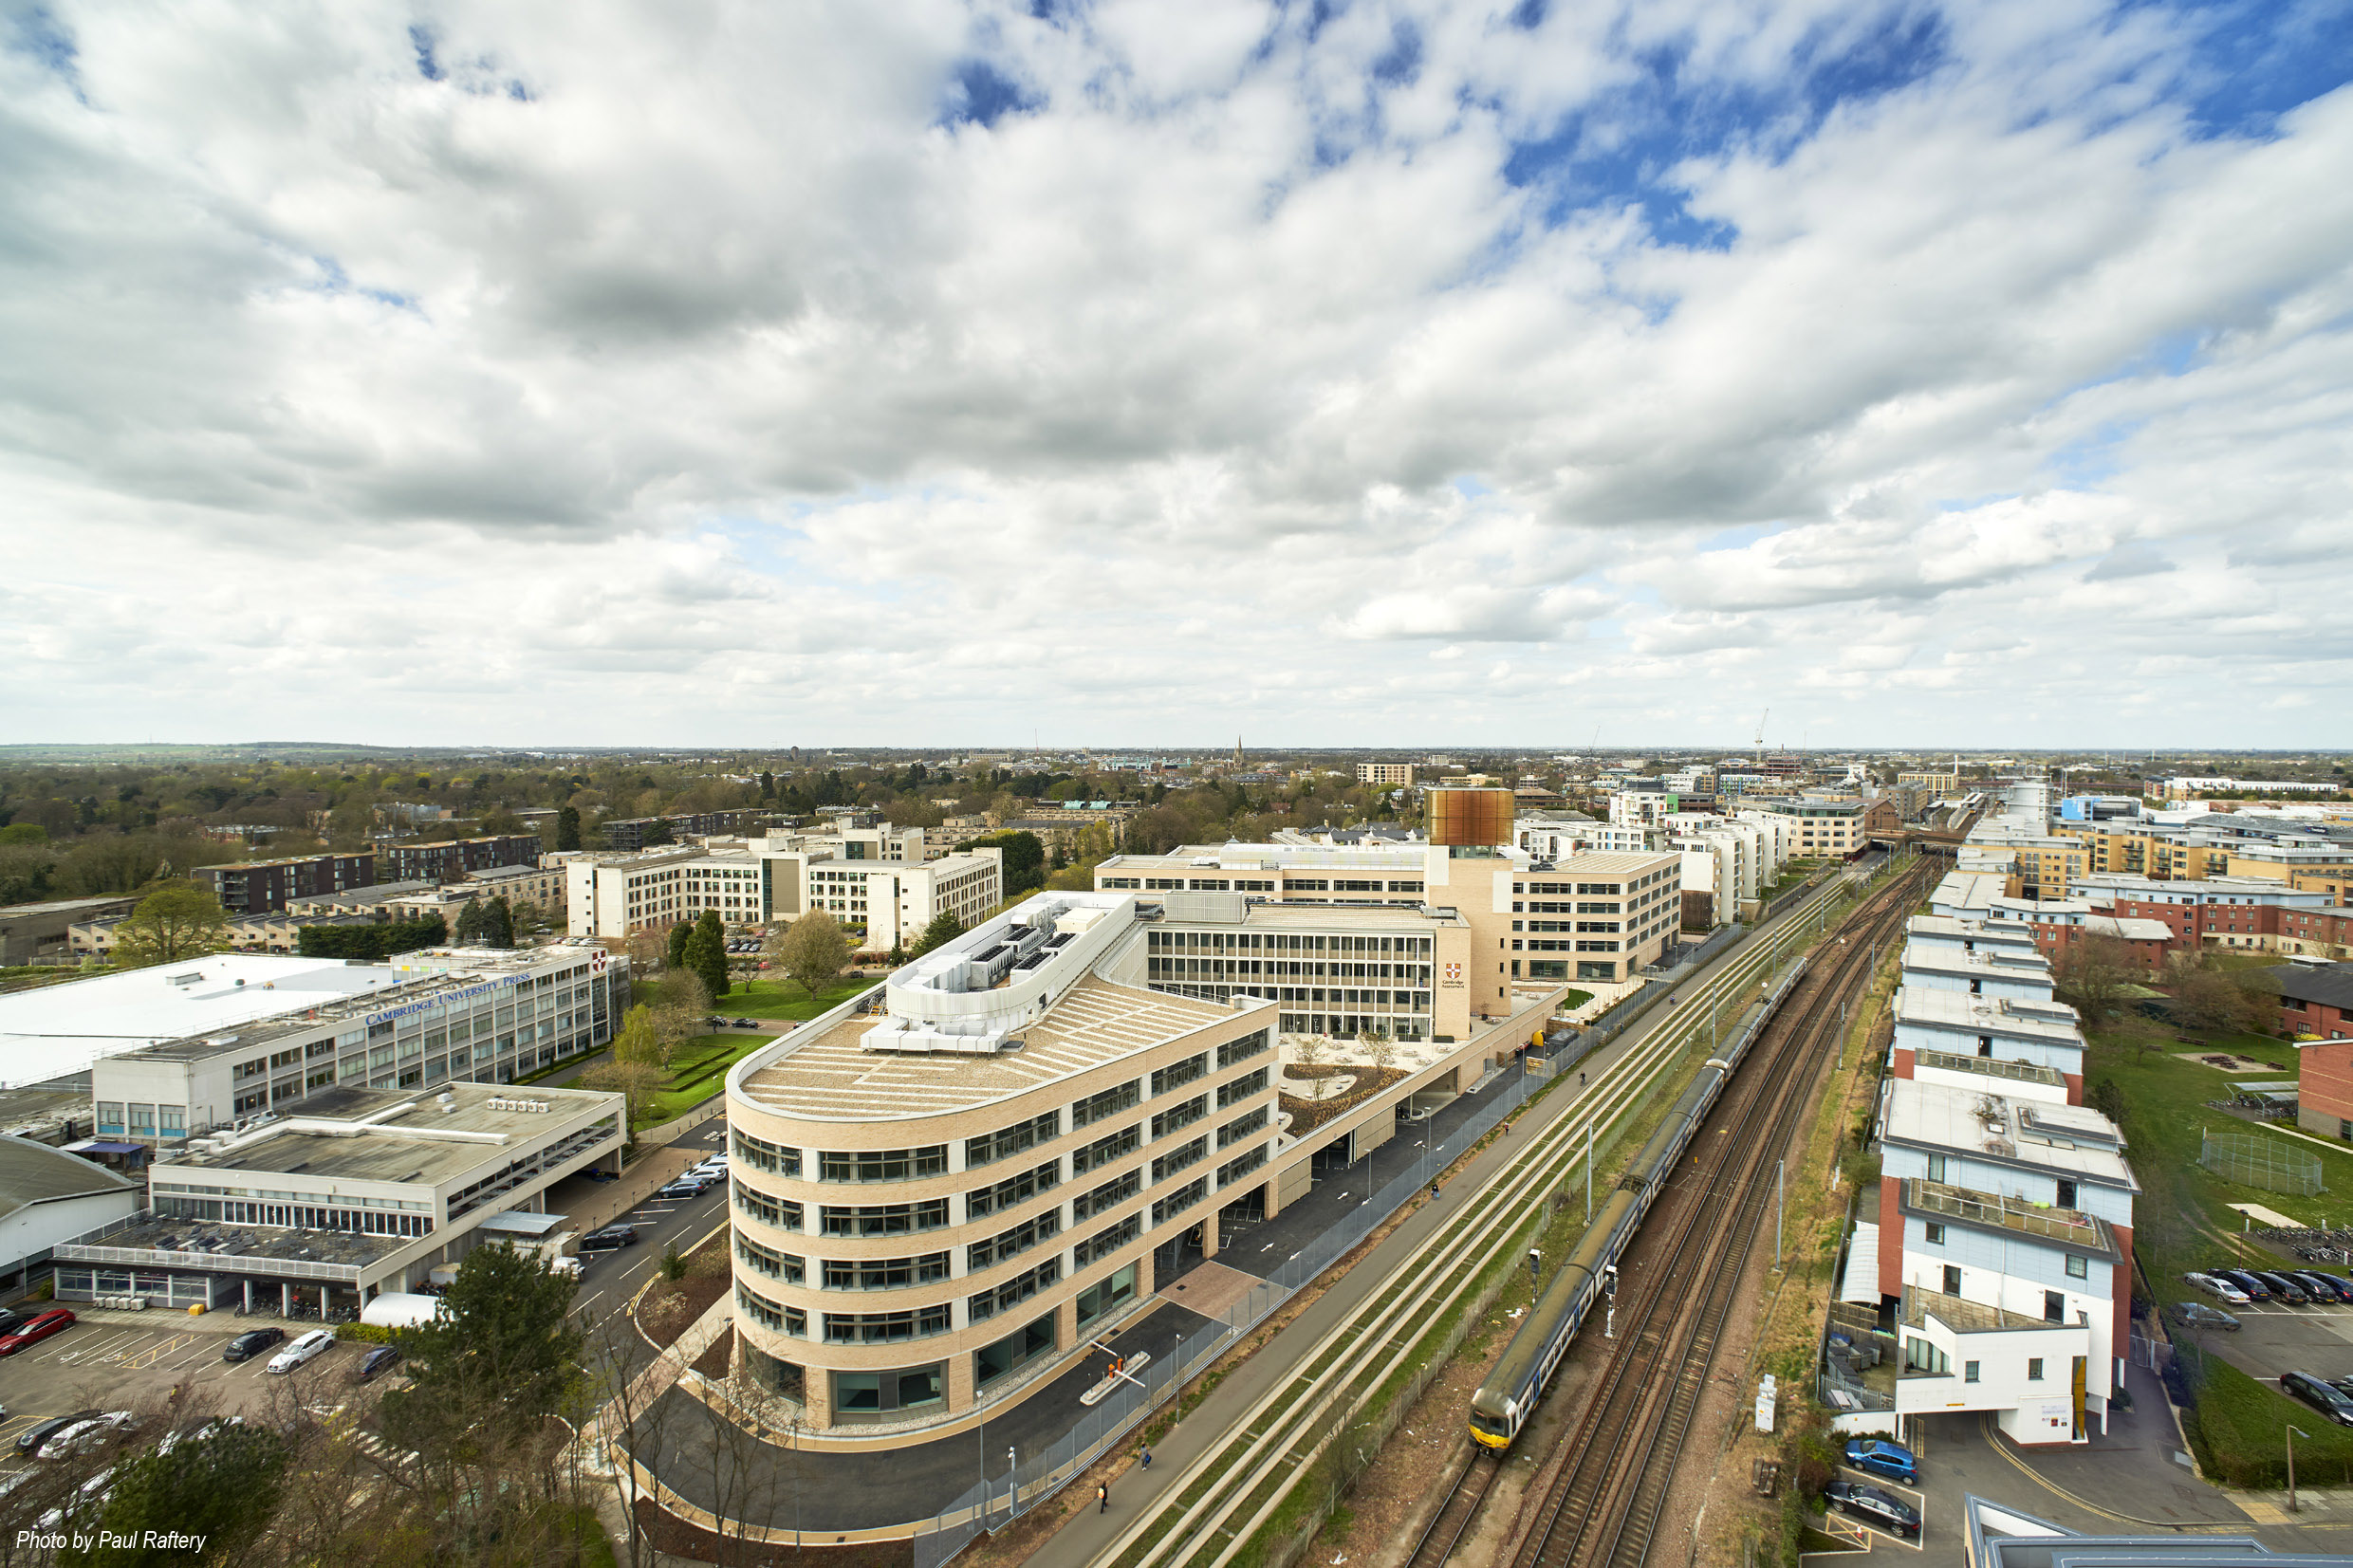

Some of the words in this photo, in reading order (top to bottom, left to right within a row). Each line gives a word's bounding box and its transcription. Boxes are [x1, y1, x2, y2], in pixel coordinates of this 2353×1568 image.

[365, 999, 435, 1025] CAMBRIDGE
[438, 981, 499, 1005] UNIVERSITY
[503, 972, 531, 987] PRESS
